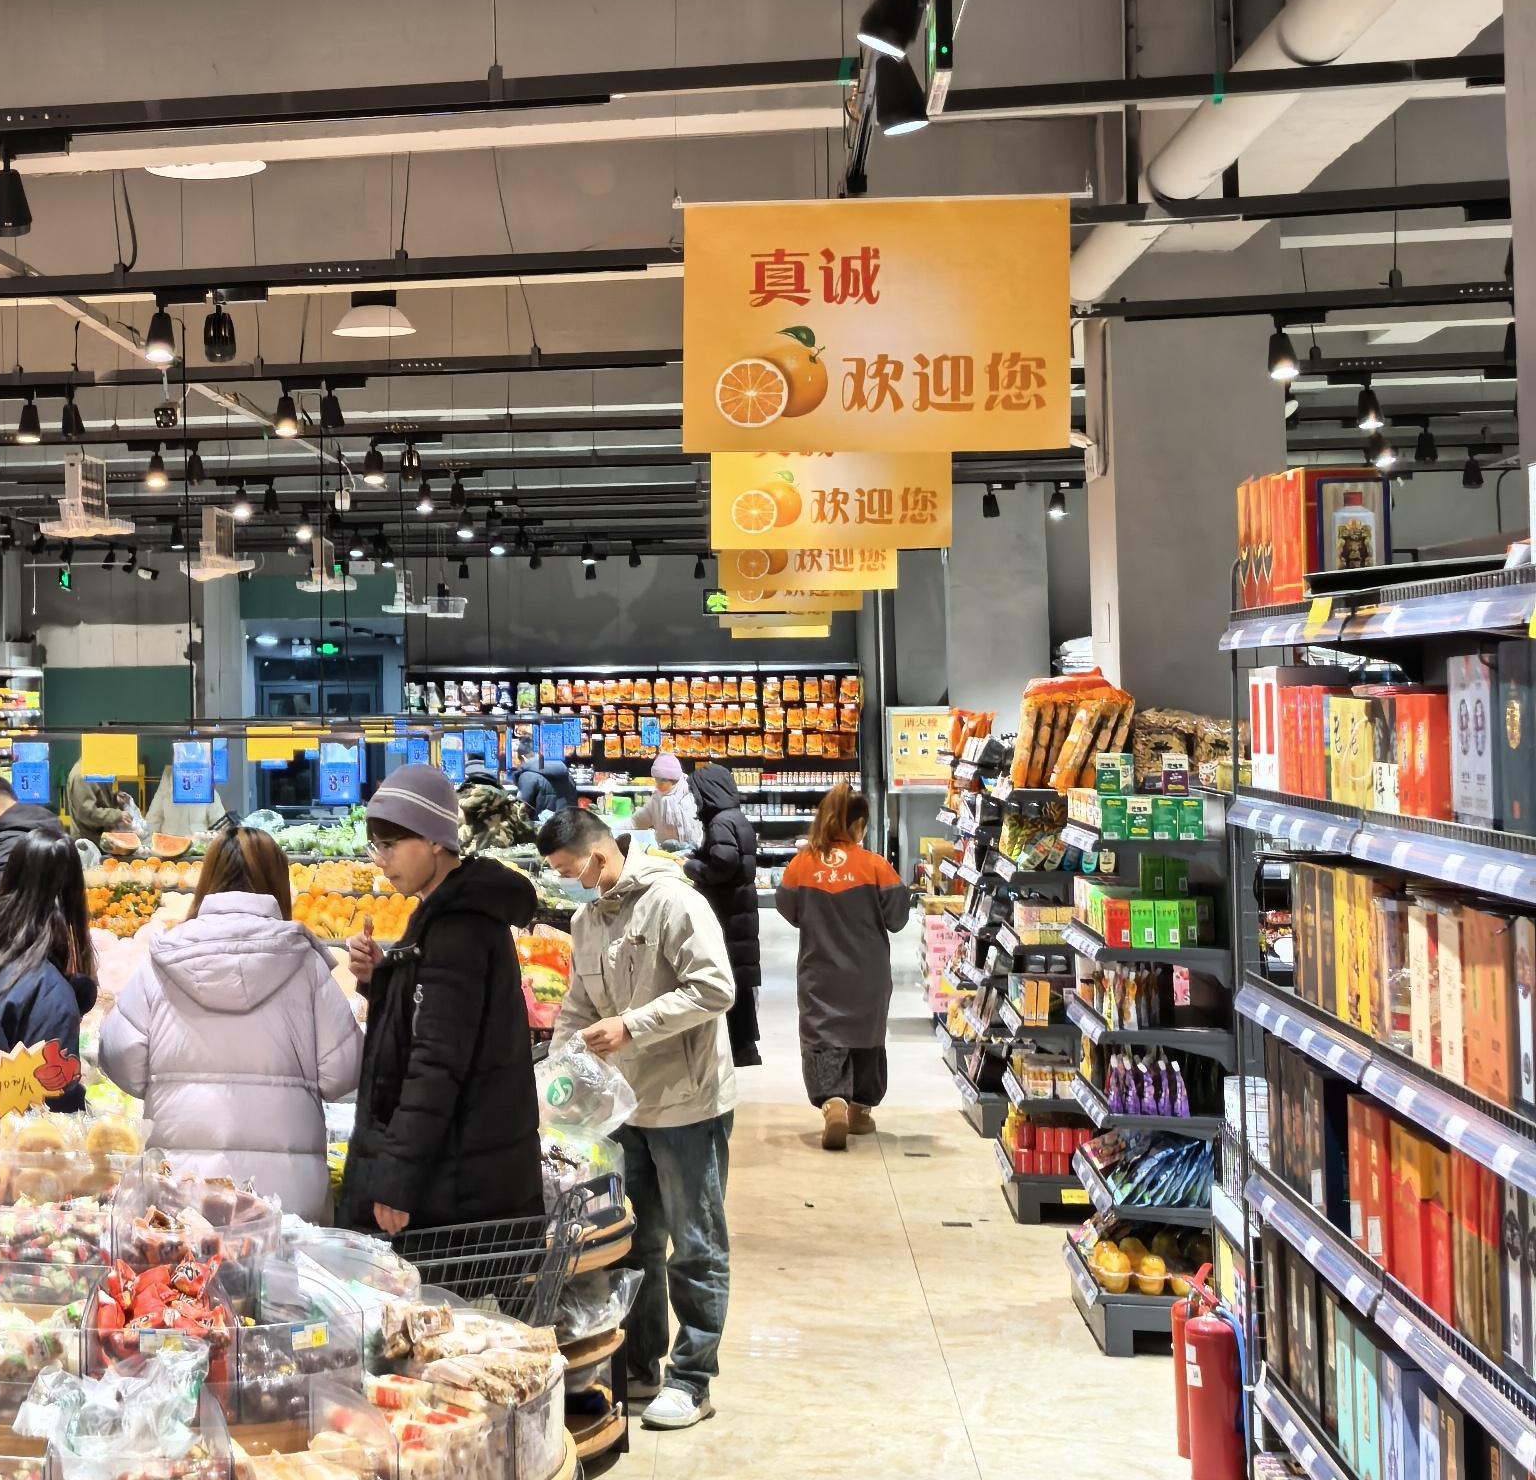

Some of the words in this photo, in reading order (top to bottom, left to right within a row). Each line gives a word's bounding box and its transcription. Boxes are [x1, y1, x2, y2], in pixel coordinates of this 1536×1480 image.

[749, 246, 881, 308] 真诚
[841, 352, 1046, 414] 欢迎您
[810, 487, 937, 526] 欢迎您
[794, 549, 886, 573] 欢迎您
